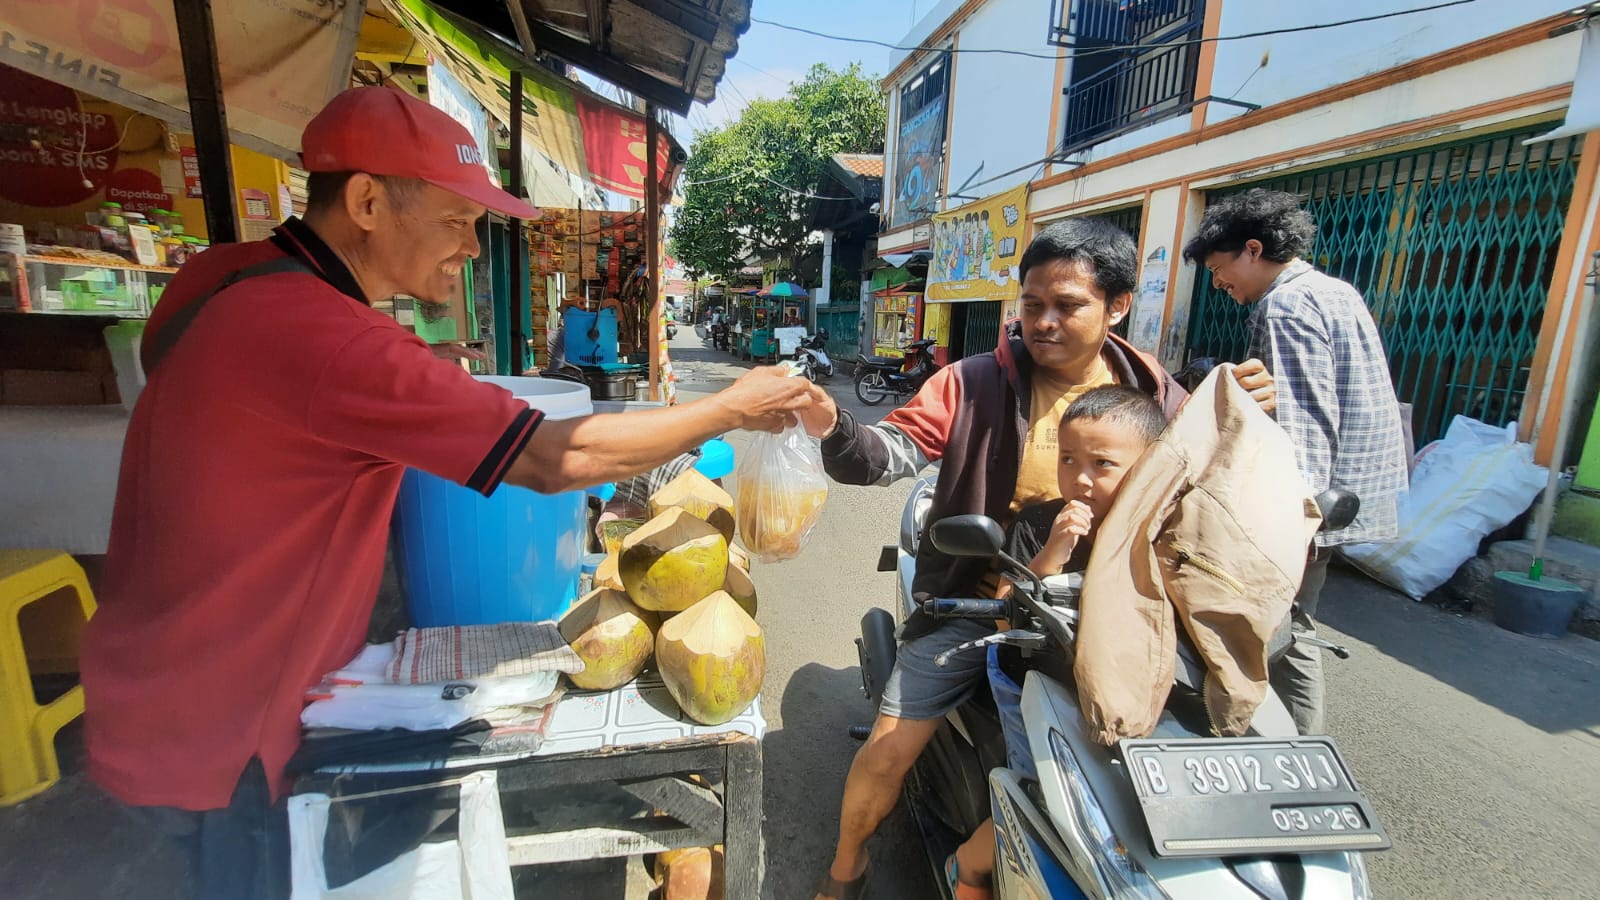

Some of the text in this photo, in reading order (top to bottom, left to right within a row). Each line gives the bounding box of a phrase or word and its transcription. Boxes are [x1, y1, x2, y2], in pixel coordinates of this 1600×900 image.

[13, 101, 106, 129] Lengkap
[61, 151, 109, 170] SMS
[110, 187, 168, 201] Dapatkan
[1142, 753, 1338, 795] B 3912 SVJ
